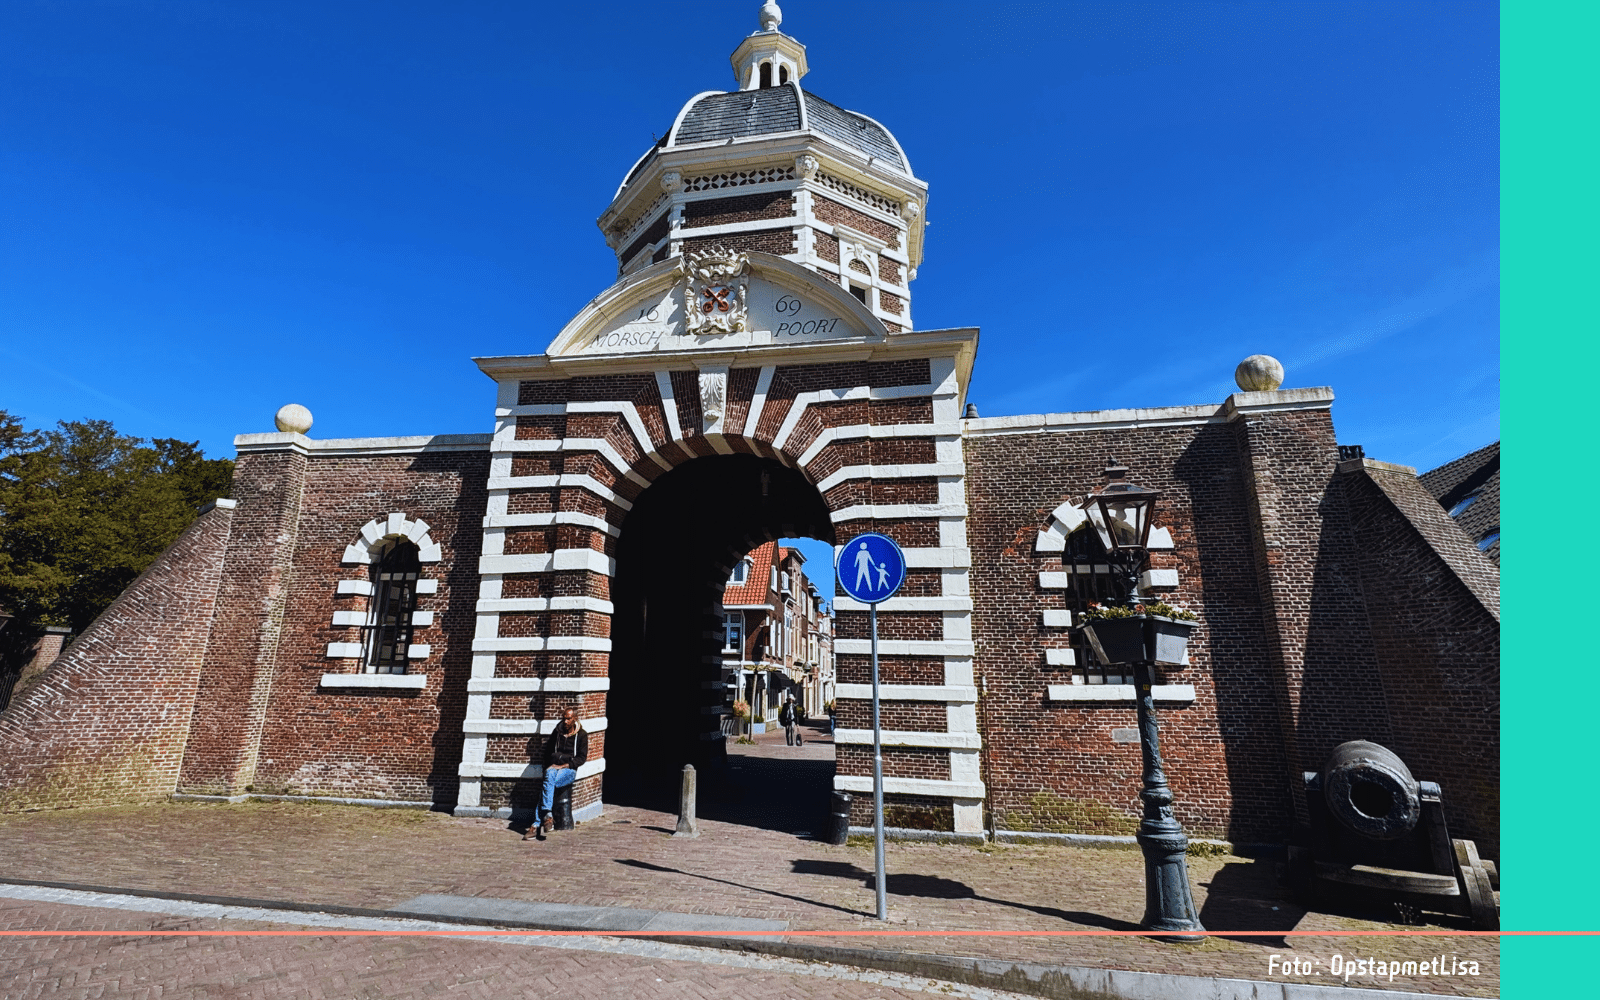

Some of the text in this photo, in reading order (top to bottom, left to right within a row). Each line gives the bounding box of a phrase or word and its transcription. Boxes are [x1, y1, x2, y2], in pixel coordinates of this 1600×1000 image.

[636, 294, 802, 322] 16 69
[589, 317, 843, 348] MORSCH POORT
